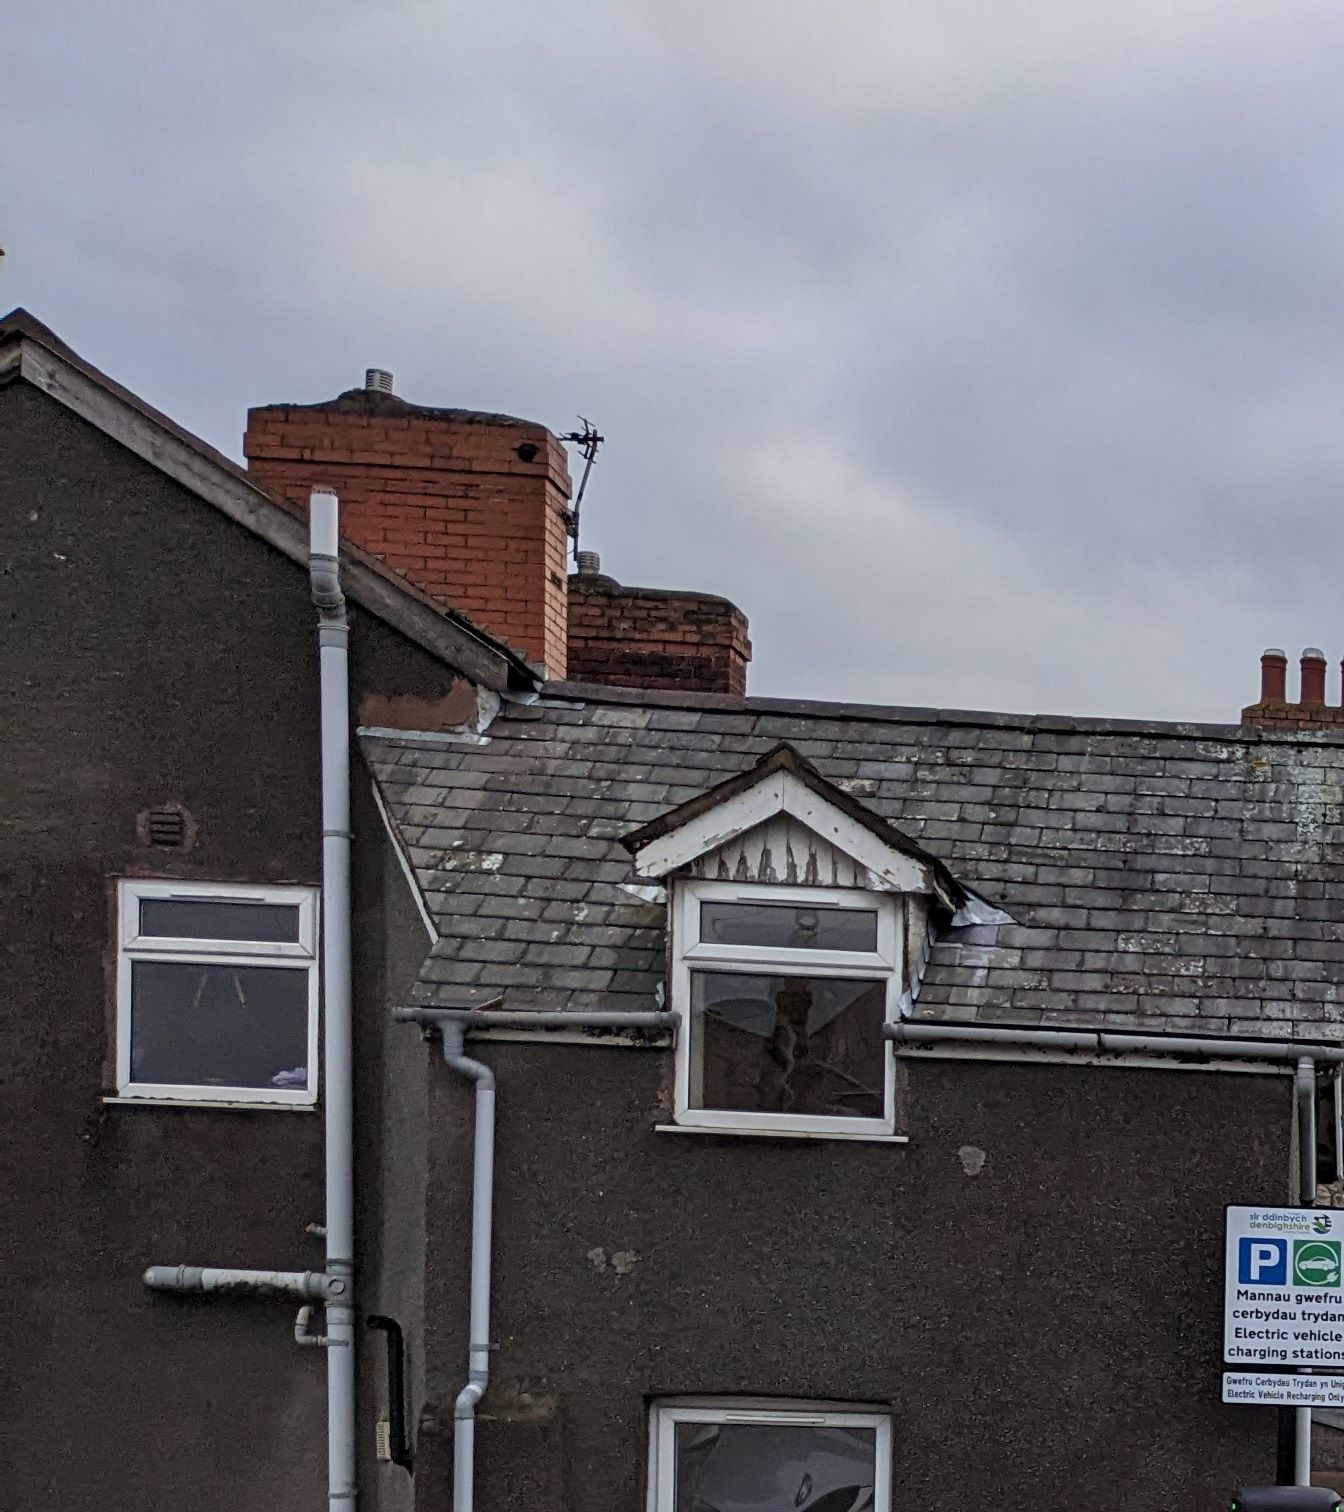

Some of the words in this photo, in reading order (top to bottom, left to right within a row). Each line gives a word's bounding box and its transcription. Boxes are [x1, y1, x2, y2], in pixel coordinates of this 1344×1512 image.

[1262, 1212, 1307, 1223] ddinbych
[1249, 1220, 1311, 1231] denbighshire
[1250, 1243, 1280, 1280] P
[1236, 1289, 1291, 1302] Mannau
[1295, 1291, 1343, 1305] gwefru
[1232, 1308, 1297, 1323] cerbydau
[1234, 1327, 1289, 1341] Electric
[1292, 1329, 1343, 1342] vehicle
[1227, 1345, 1288, 1361] charging
[1226, 1376, 1253, 1386] Gwefru
[1255, 1377, 1290, 1388] Cerbydau
[1293, 1378, 1318, 1389] Trydan
[1319, 1381, 1329, 1390] yn
[1227, 1389, 1255, 1399] Electric
[1258, 1390, 1285, 1400] Vehicle
[1286, 1391, 1326, 1402] Recharging
[1327, 1393, 1344, 1402] Only
